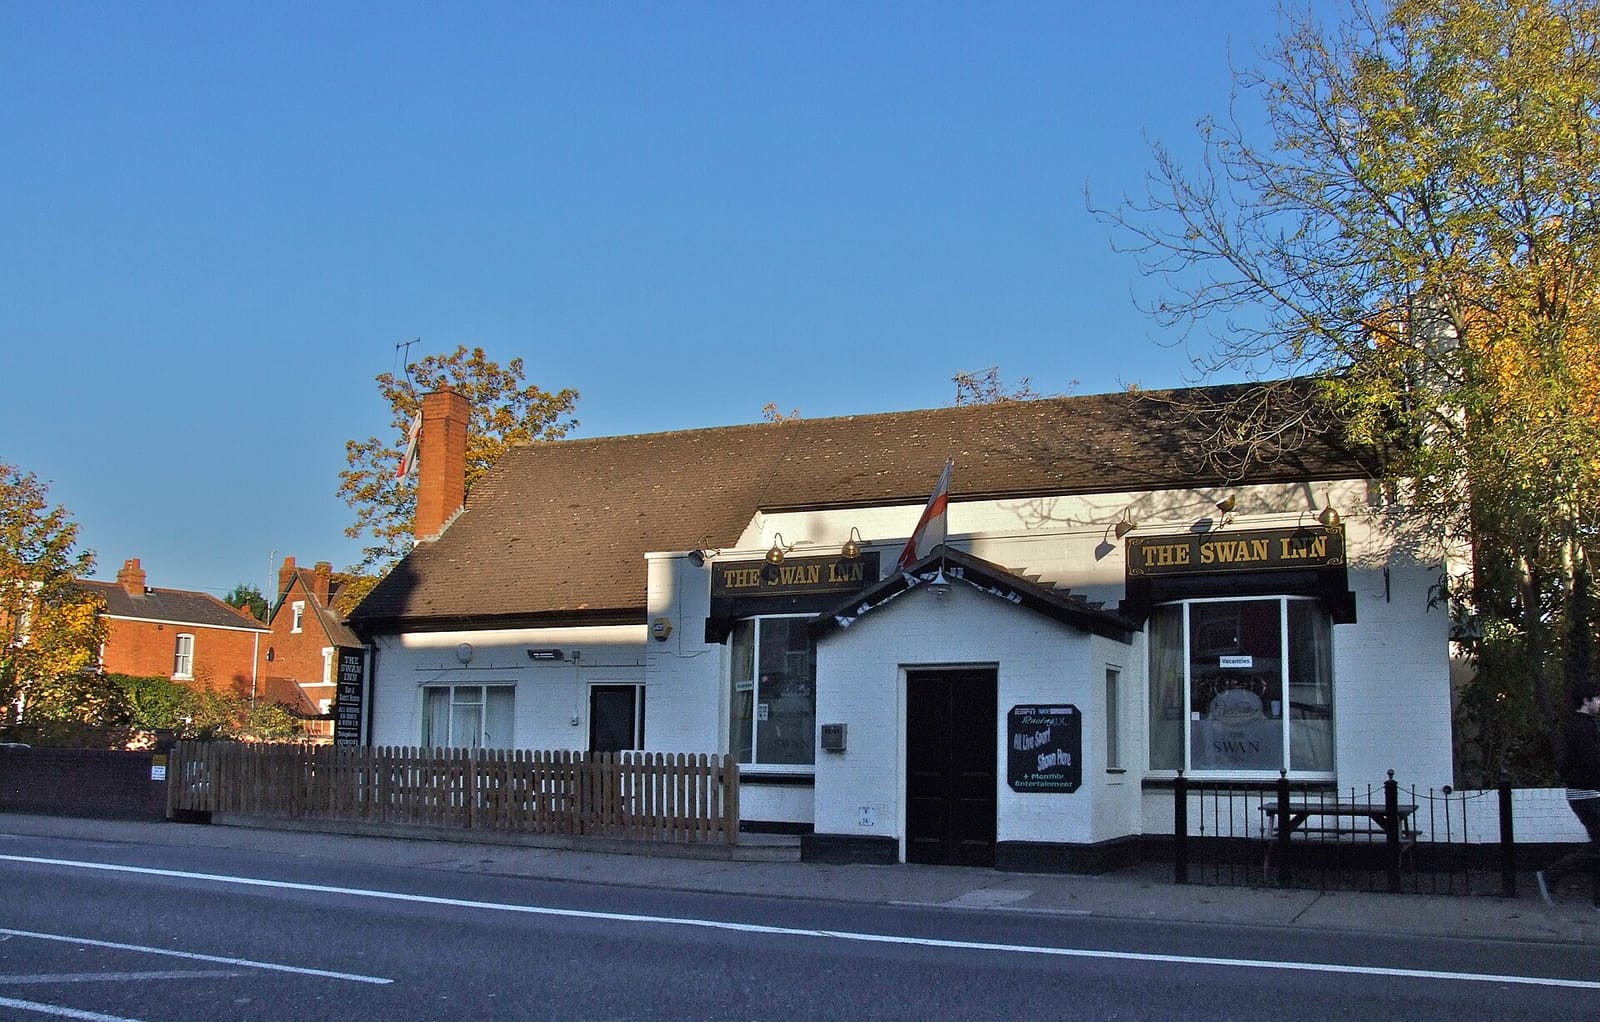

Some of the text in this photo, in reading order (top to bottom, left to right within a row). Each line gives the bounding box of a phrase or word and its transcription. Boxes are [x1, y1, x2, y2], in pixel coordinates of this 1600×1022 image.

[1142, 535, 1328, 567] THE SWAN INN
[724, 568, 760, 588] THE
[344, 656, 359, 665] THE
[1221, 657, 1250, 665] Vacancies
[341, 664, 361, 674] SWAN
[343, 673, 358, 682] INN
[1023, 734, 1034, 751] Live
[1213, 741, 1260, 753] SWAN
[1014, 780, 1072, 788] Entertainment
